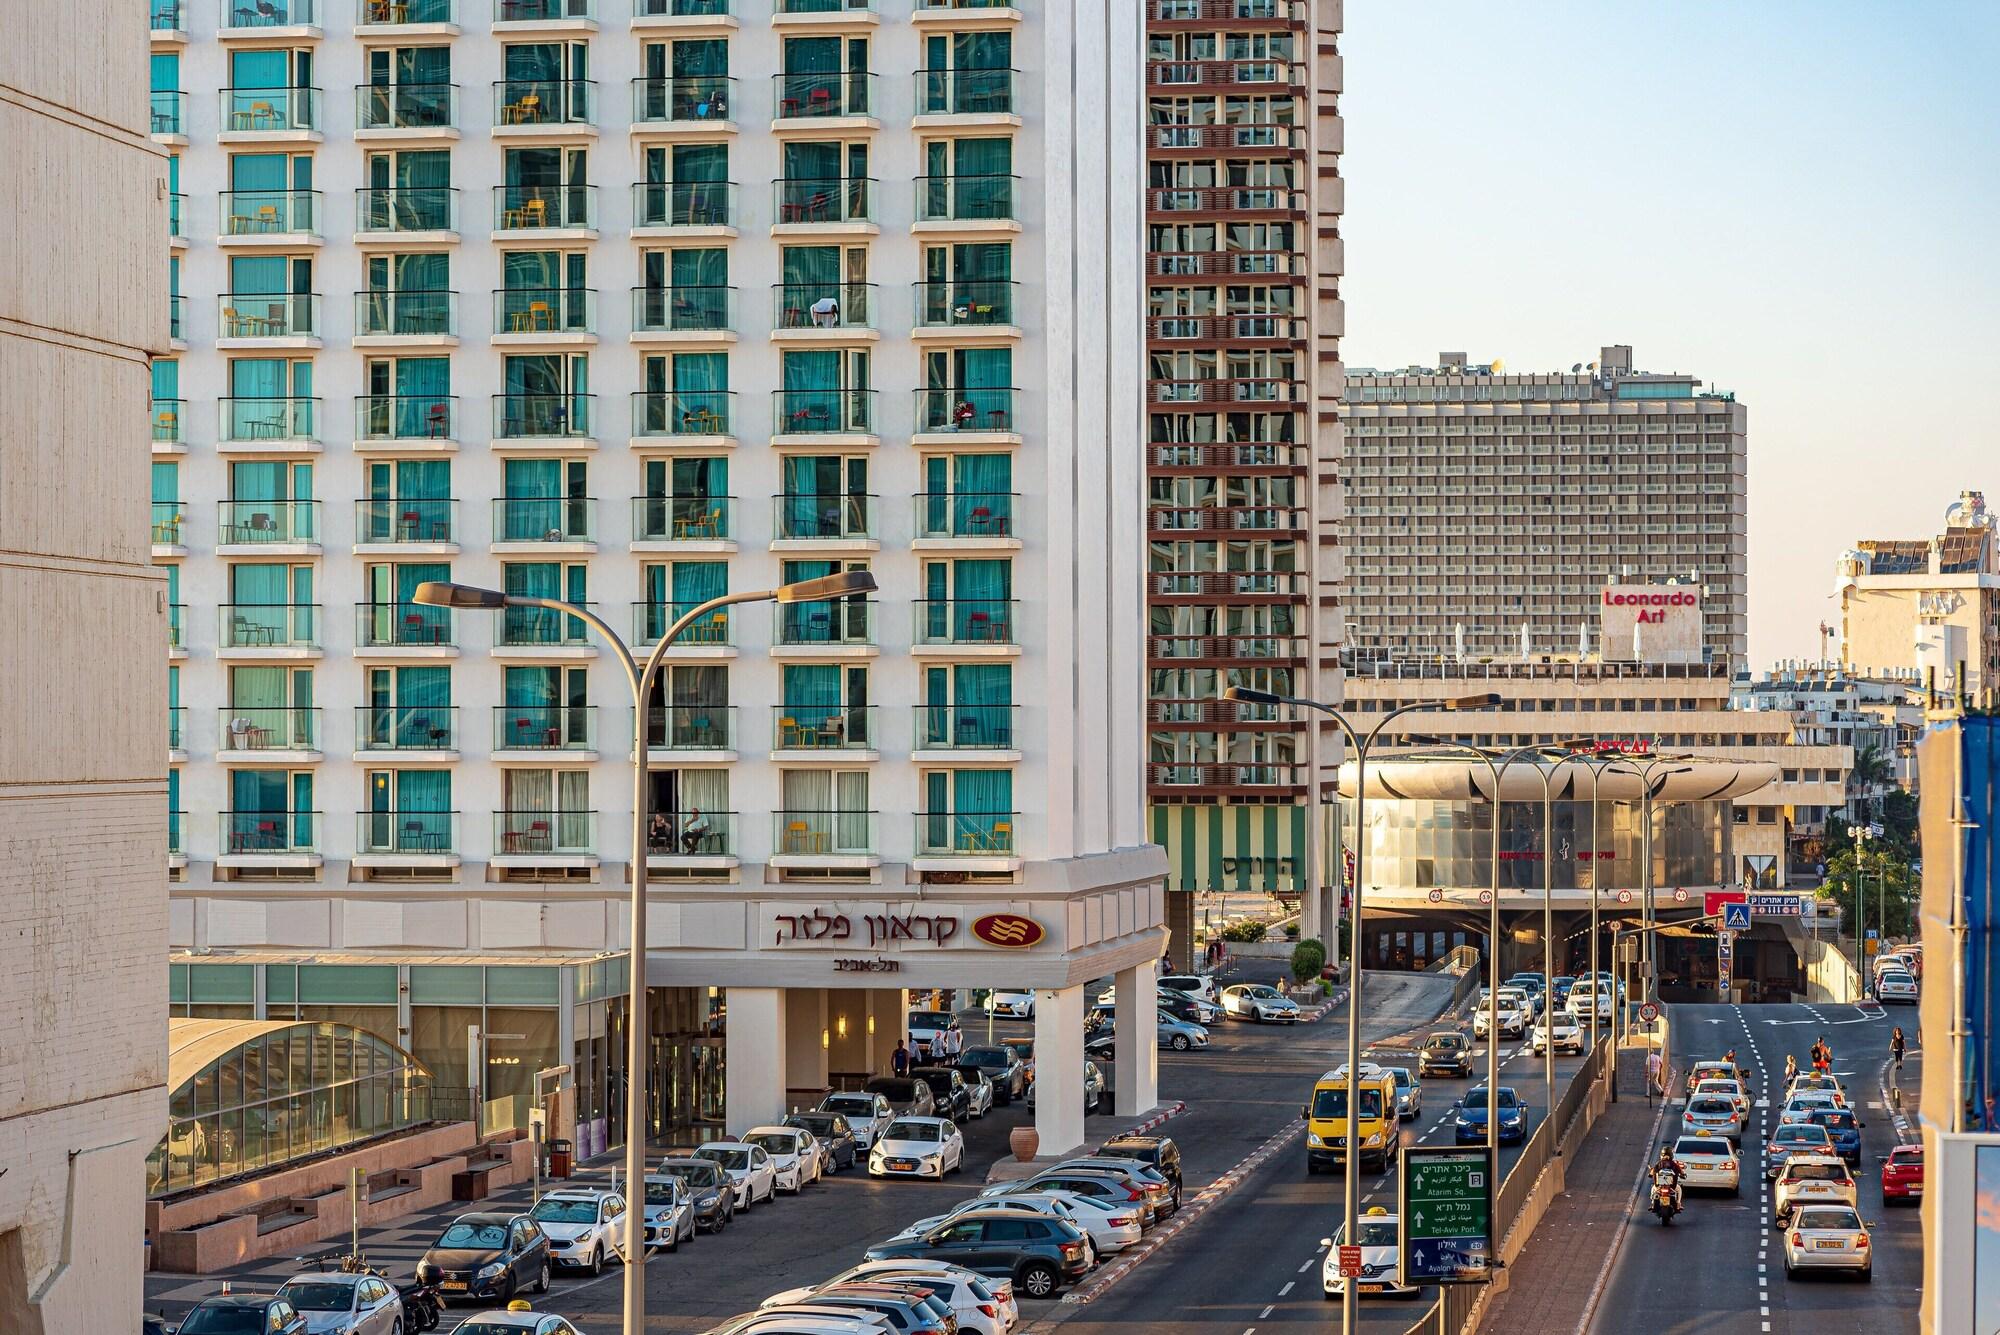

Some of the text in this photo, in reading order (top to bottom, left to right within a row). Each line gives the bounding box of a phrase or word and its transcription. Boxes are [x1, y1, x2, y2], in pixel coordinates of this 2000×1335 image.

[1604, 591, 1696, 606] Leonardo
[1637, 608, 1665, 624] Art
[1783, 896, 1799, 905] חניון
[774, 906, 958, 948] קראון פלזה
[833, 955, 900, 973] תל-אביב
[1422, 1165, 1471, 1174] כיכר אתרים
[1454, 1188, 1467, 1197] Sq.
[1455, 1202, 1471, 1211] נמל
[1431, 1225, 1476, 1234] Tel-Aviv Port
[1437, 1240, 1457, 1251] אילון
[1428, 1265, 1451, 1273] Ayalon
